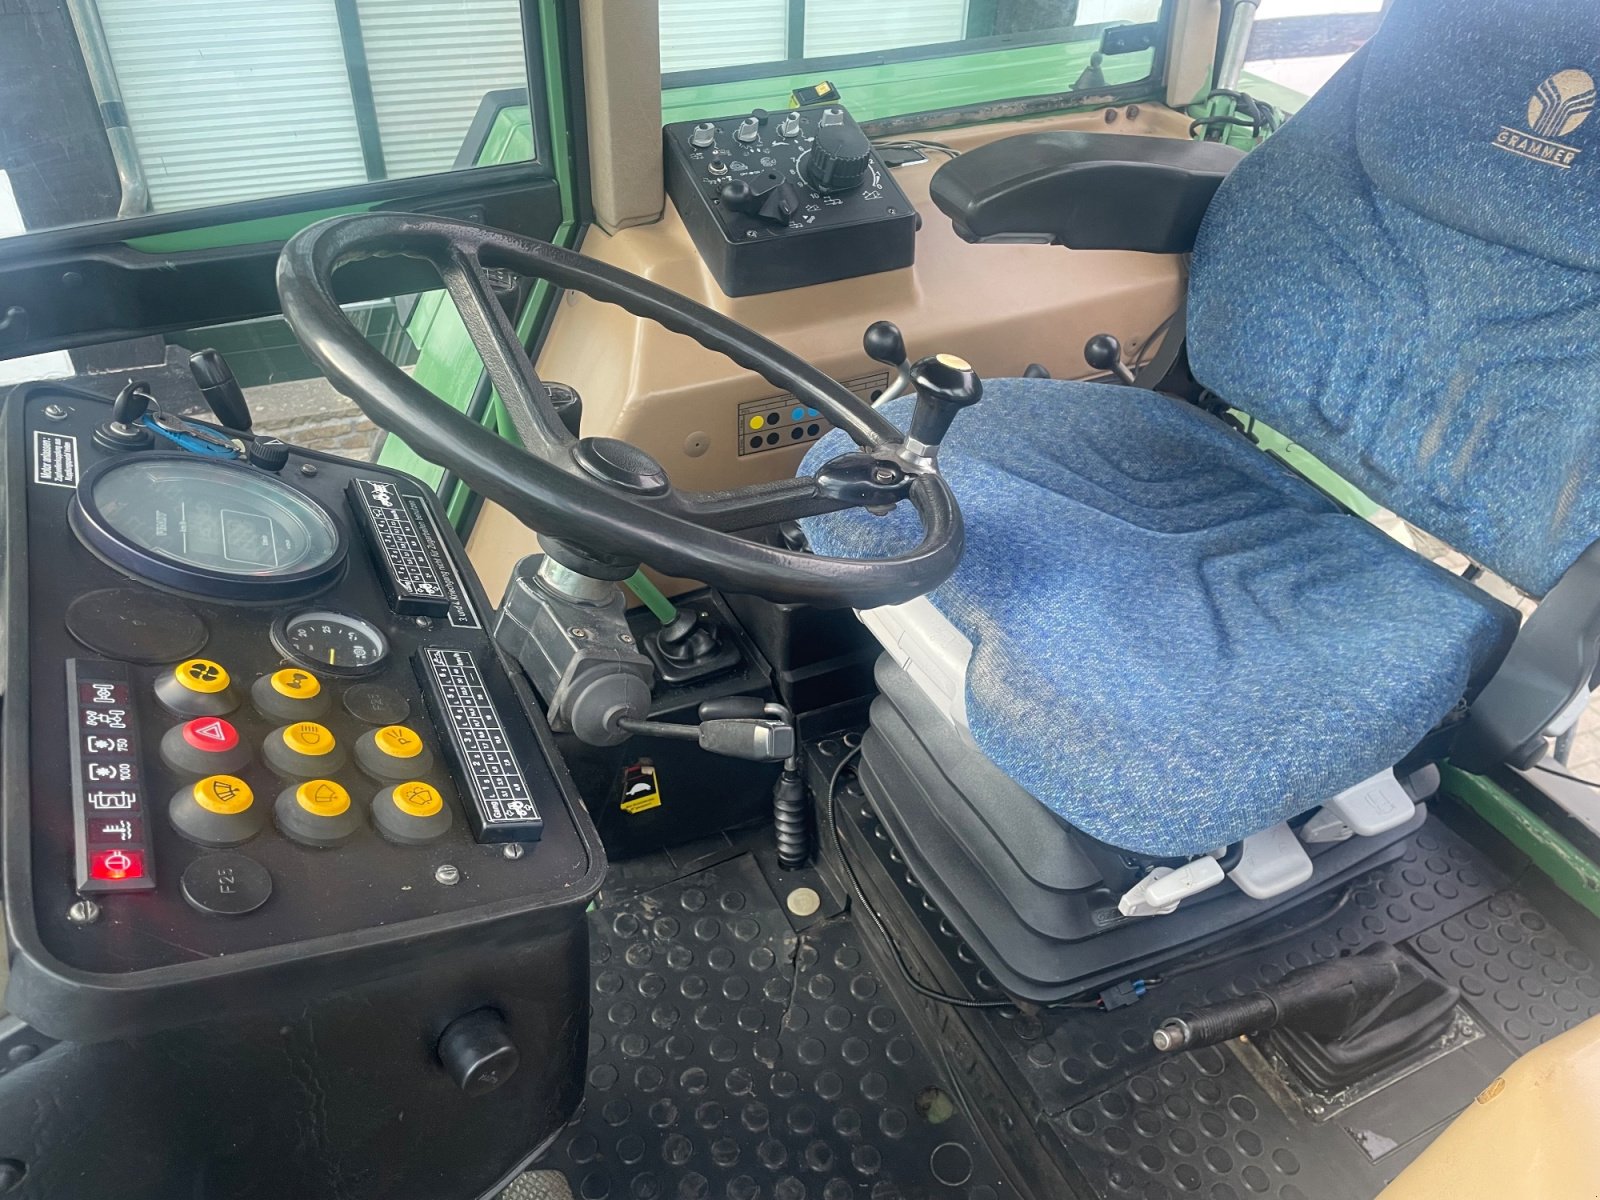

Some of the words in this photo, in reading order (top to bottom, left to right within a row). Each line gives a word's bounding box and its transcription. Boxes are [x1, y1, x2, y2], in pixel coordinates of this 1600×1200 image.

[1497, 131, 1575, 164] GRAMMER
[298, 629, 307, 637] 20
[117, 738, 128, 752] 750
[119, 764, 131, 780] 1000
[490, 801, 502, 818] Gang
[218, 868, 236, 893] F25
